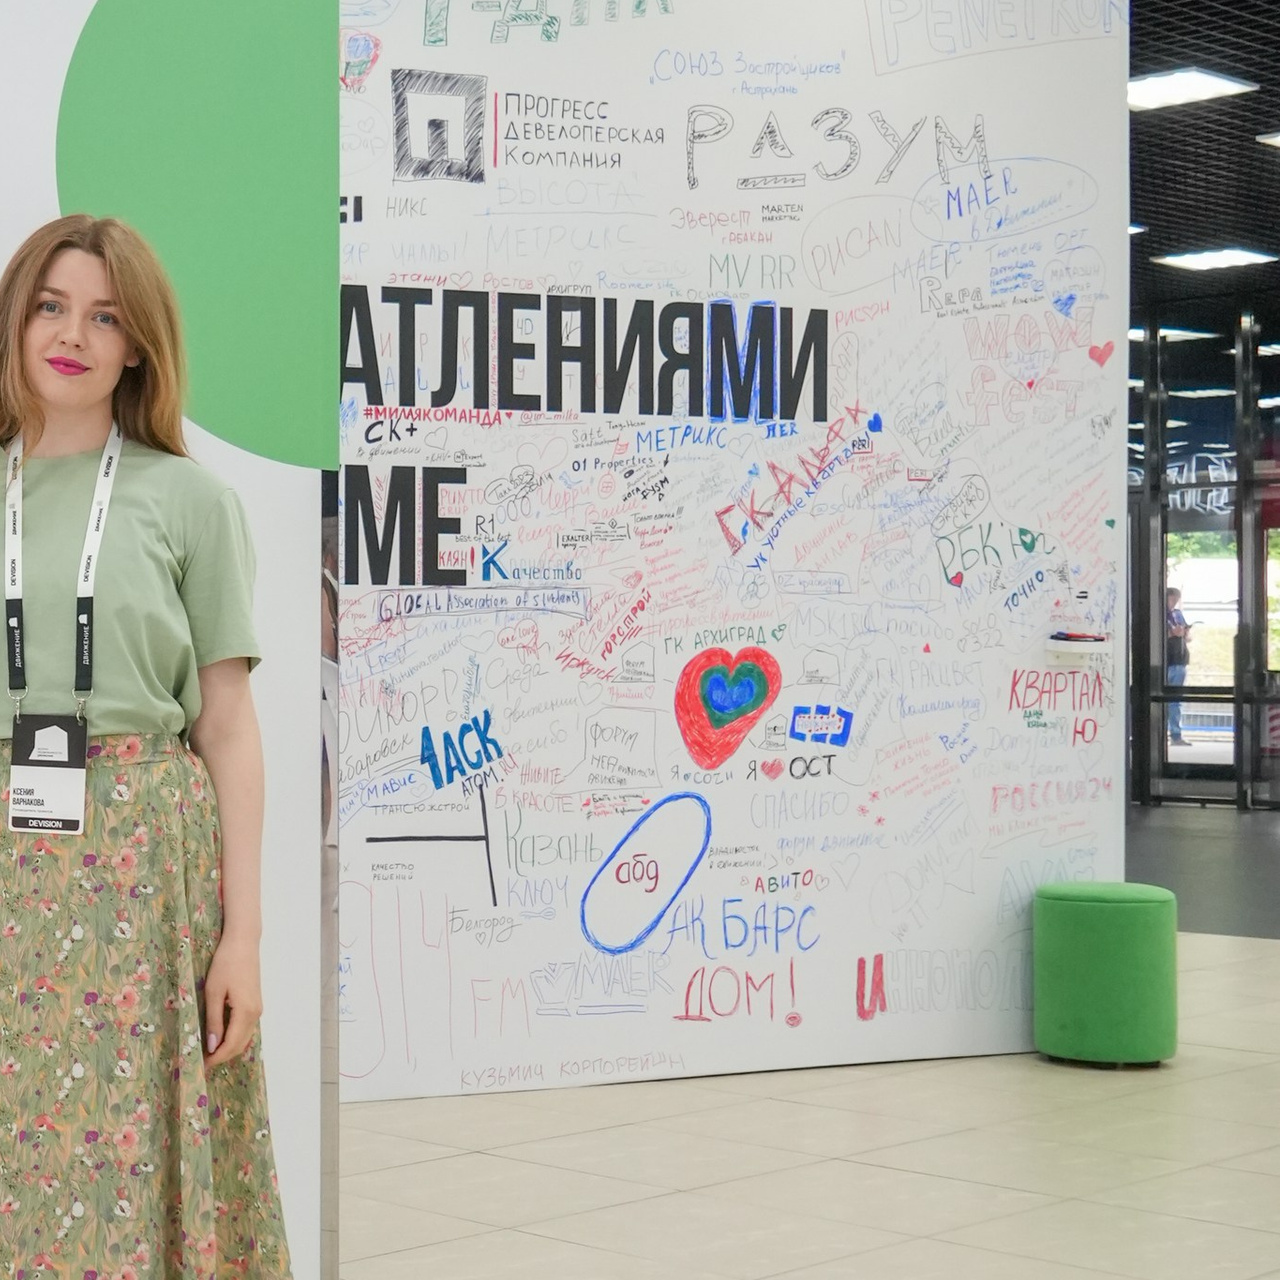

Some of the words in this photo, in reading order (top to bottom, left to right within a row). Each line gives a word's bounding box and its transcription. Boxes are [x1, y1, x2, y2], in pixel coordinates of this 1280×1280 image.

[504, 92, 609, 120] ПРОГРЕСС
[503, 121, 665, 145] ДЕВЕЛОПЕРСКАЯ
[385, 196, 429, 219] НИКС
[946, 166, 1018, 221] MAER
[669, 206, 751, 236] Эверест
[761, 203, 804, 214] MARTEN
[729, 231, 773, 245] АБАКАН
[635, 424, 728, 454] МЕТРИКС
[104, 455, 114, 478] DEVISION
[593, 454, 654, 474] Properties
[83, 554, 93, 583] DEVISION
[14, 627, 23, 669] ДВИЖЕНИЕ
[83, 624, 91, 666] ДВИЖЕНИЕ
[663, 637, 683, 655] ГК
[694, 625, 767, 650] АРХИГРАД
[1008, 669, 1104, 713] КВАРТАЛ
[746, 759, 757, 782] Я
[788, 753, 838, 780] ОСТ
[12, 787, 35, 796] КСЕНИЯ
[367, 772, 418, 801] МАВИС
[28, 819, 63, 829] DEVISION
[750, 789, 850, 830] СПАСИБО
[507, 875, 569, 909] КЛЮЧ
[754, 868, 815, 894] АВИТО
[448, 904, 523, 949] Белгород
[722, 896, 821, 957] БАРС
[460, 1064, 544, 1090] КУЗЬМИЧ
